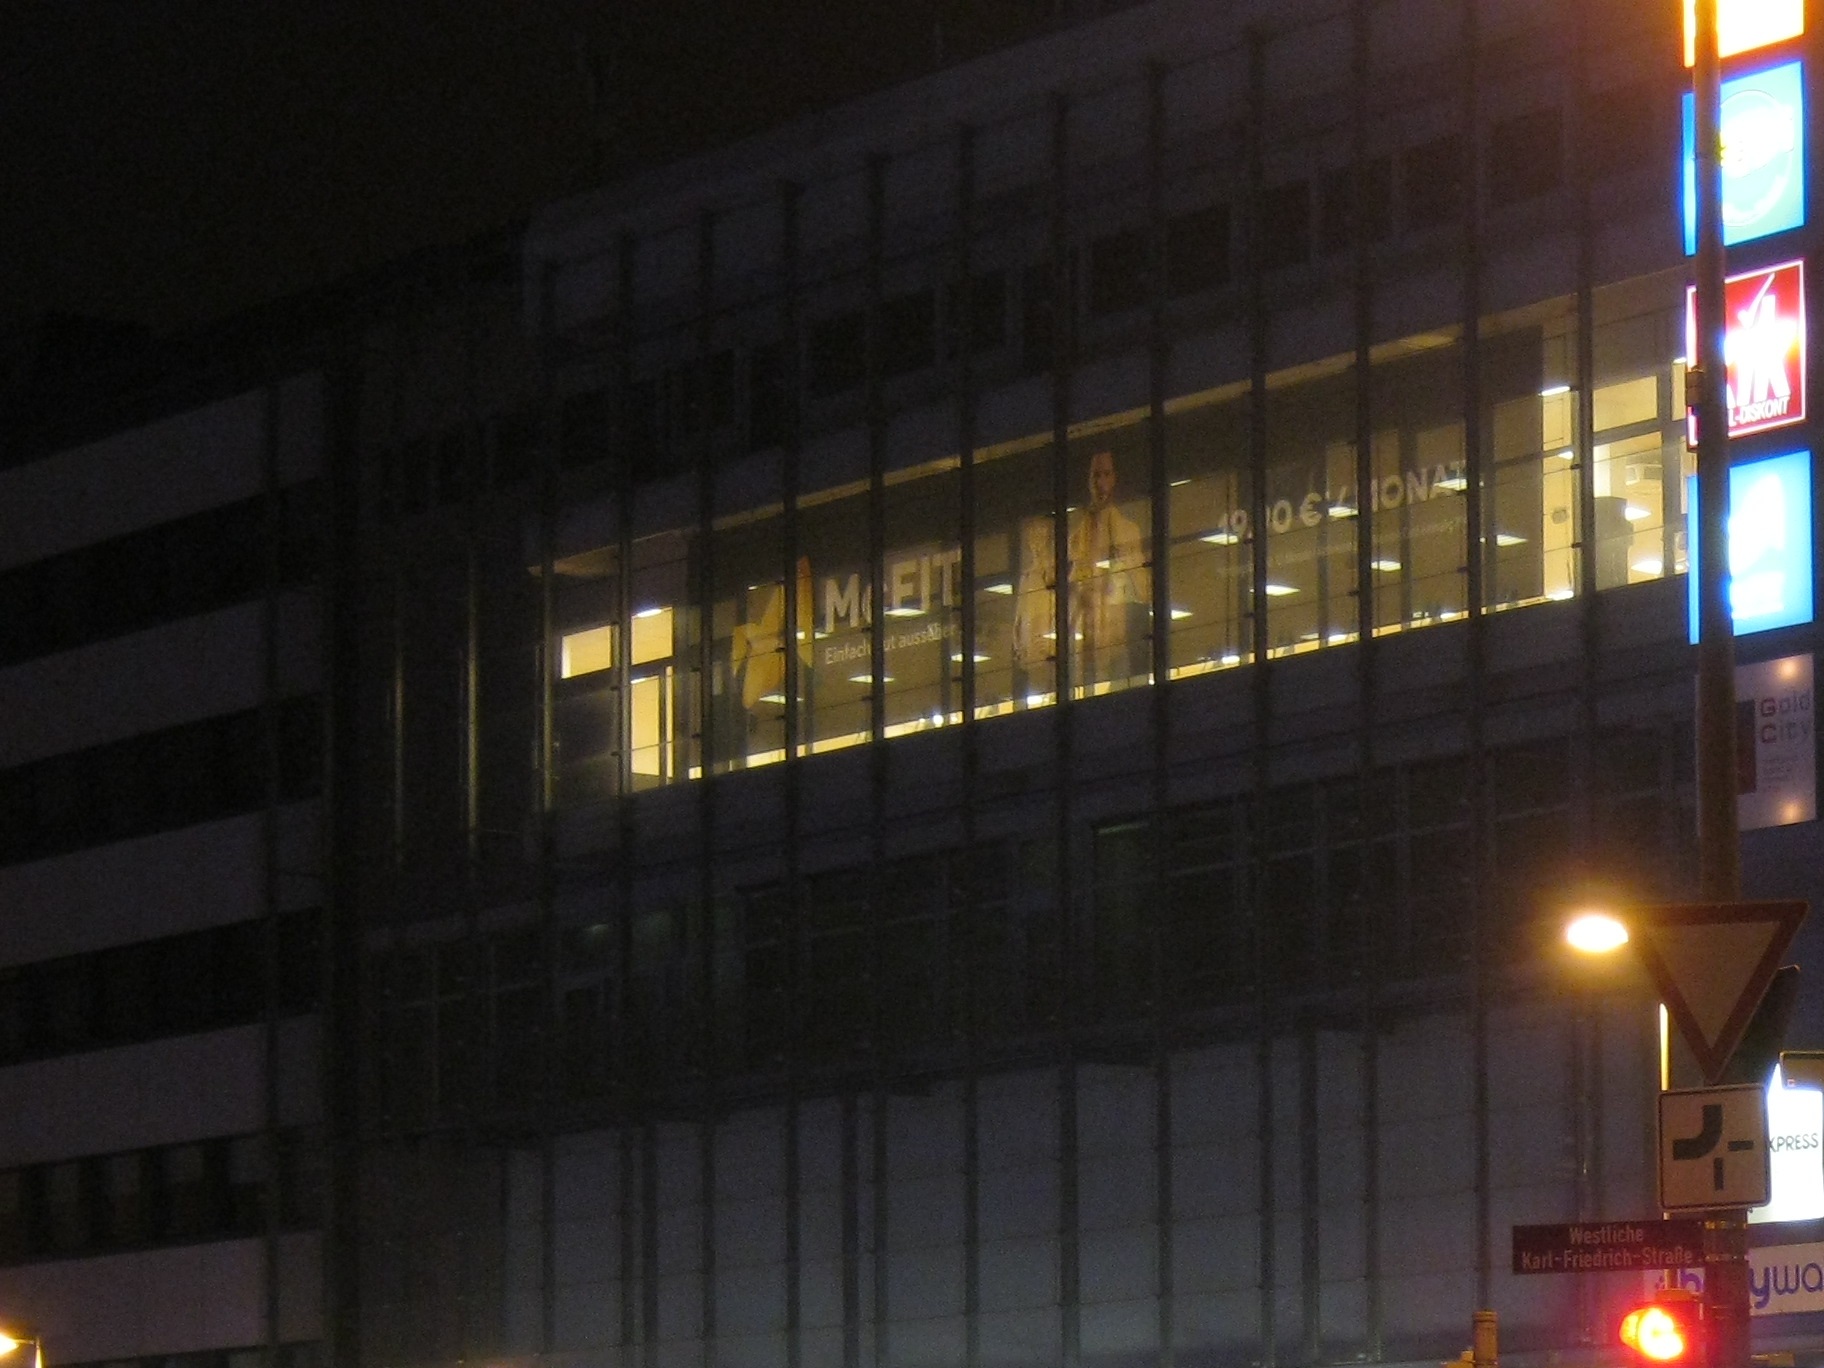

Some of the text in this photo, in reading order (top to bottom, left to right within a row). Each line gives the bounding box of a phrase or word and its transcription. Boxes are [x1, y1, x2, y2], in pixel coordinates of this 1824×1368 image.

[1769, 1133, 1819, 1152] XPRESS
[1569, 1226, 1644, 1245] Westliche
[1521, 1246, 1693, 1271] Karl-Friedrich-Straße
